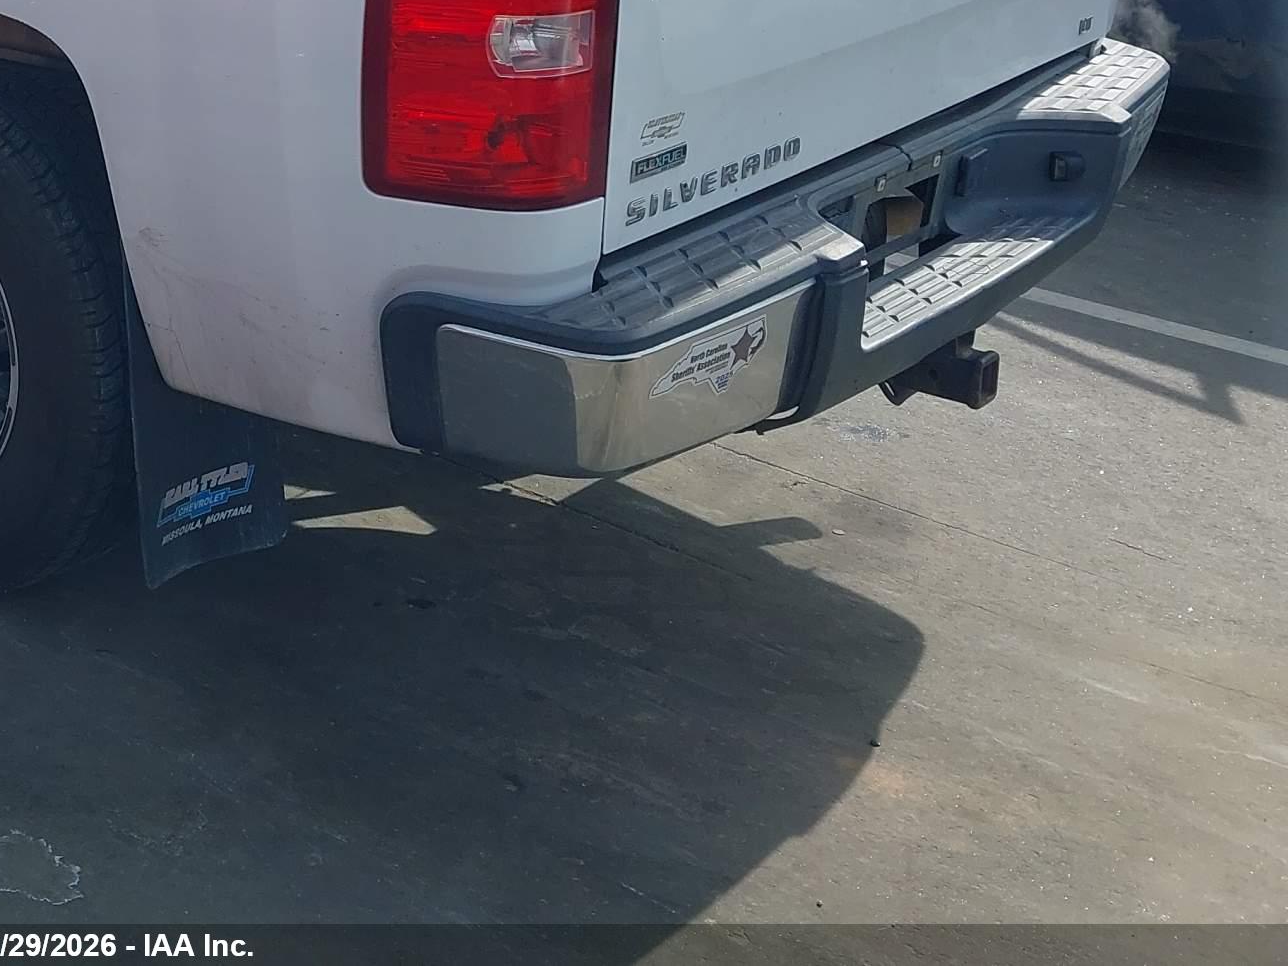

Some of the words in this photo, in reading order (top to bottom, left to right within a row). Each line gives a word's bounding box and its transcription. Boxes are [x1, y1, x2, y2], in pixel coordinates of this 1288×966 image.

[625, 135, 802, 226] SILVERADO
[178, 491, 226, 517] CHEVROLET
[205, 504, 253, 525] MONTANA
